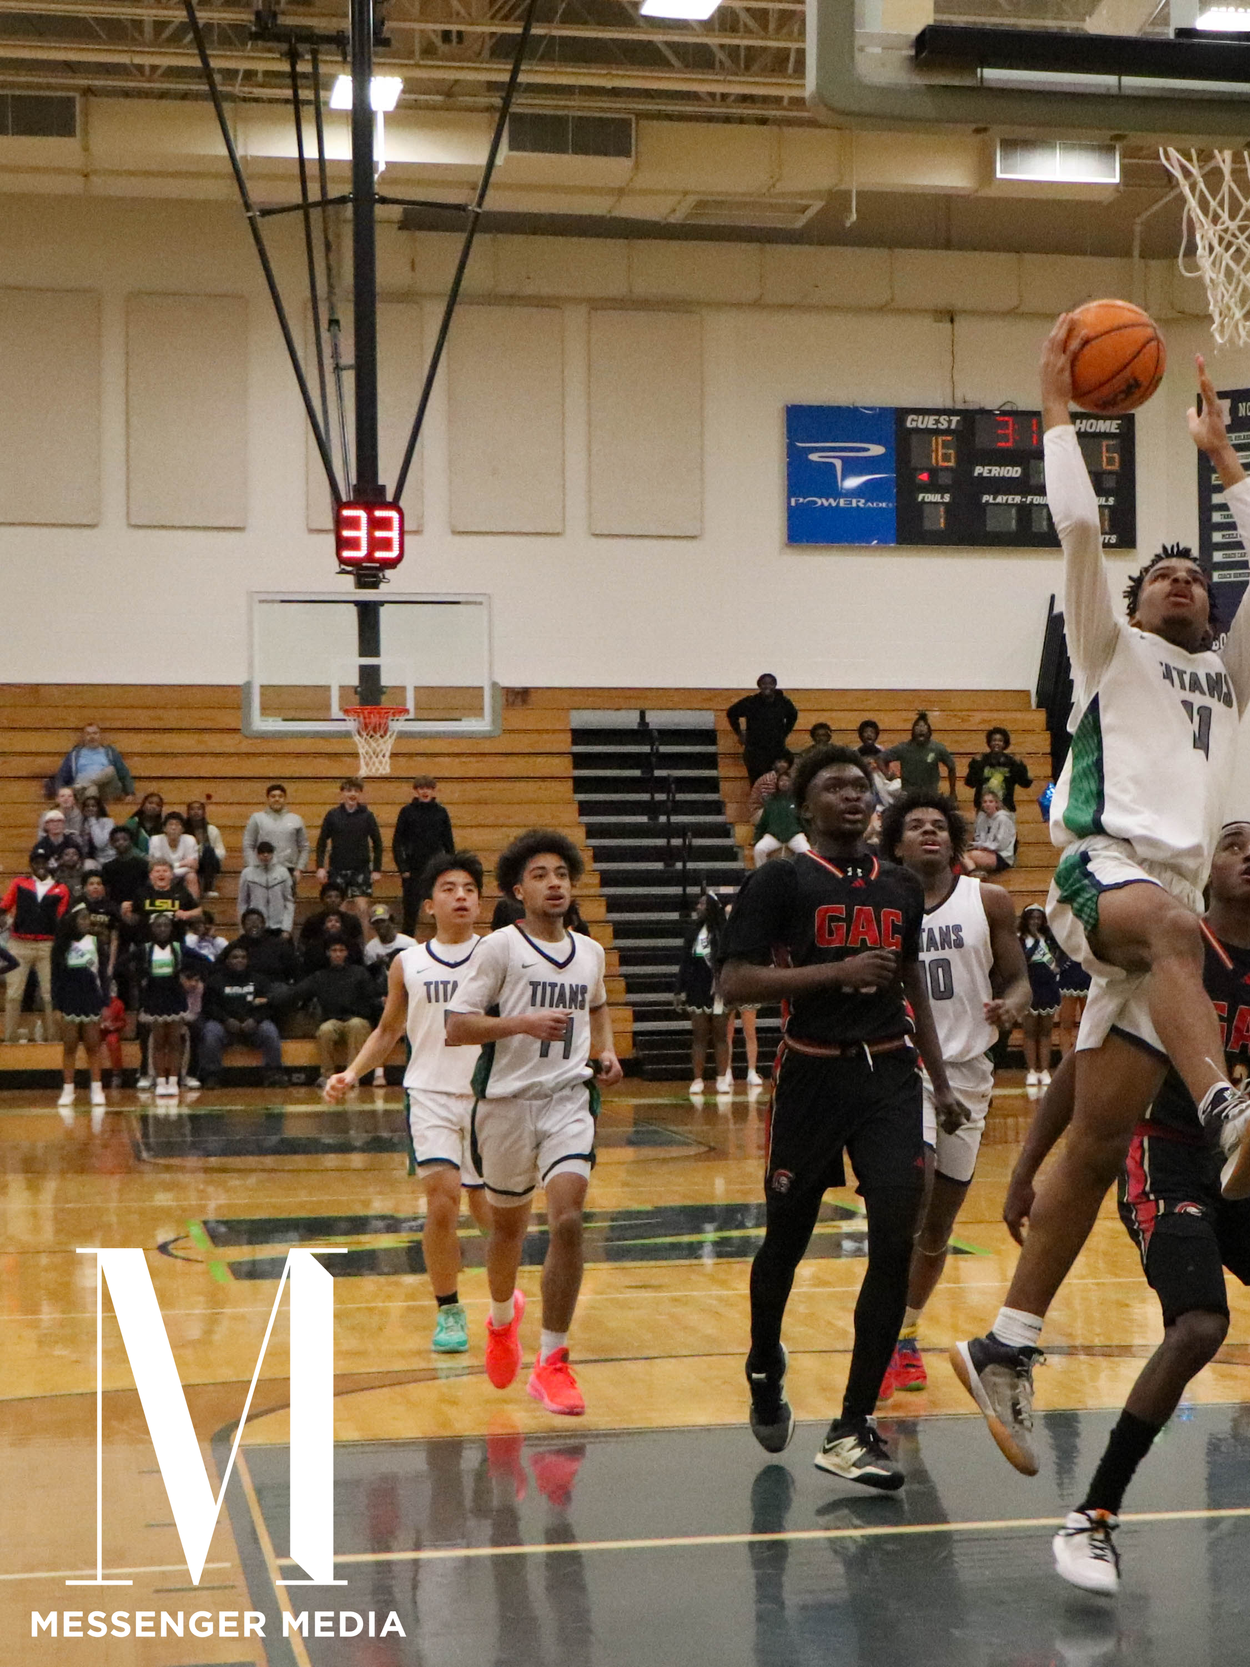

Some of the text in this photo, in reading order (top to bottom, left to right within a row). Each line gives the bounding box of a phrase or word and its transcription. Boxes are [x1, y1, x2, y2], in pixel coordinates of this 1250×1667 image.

[906, 414, 960, 429] GUEST
[1076, 419, 1121, 433] HOME
[1102, 440, 1120, 470] 6
[974, 466, 1021, 477] PERIOD
[918, 493, 950, 502] FOULS
[341, 509, 400, 558] 33
[145, 899, 180, 911] LSU
[815, 905, 902, 950] GAC
[919, 924, 965, 953] TANS
[529, 981, 588, 1010] TITANS
